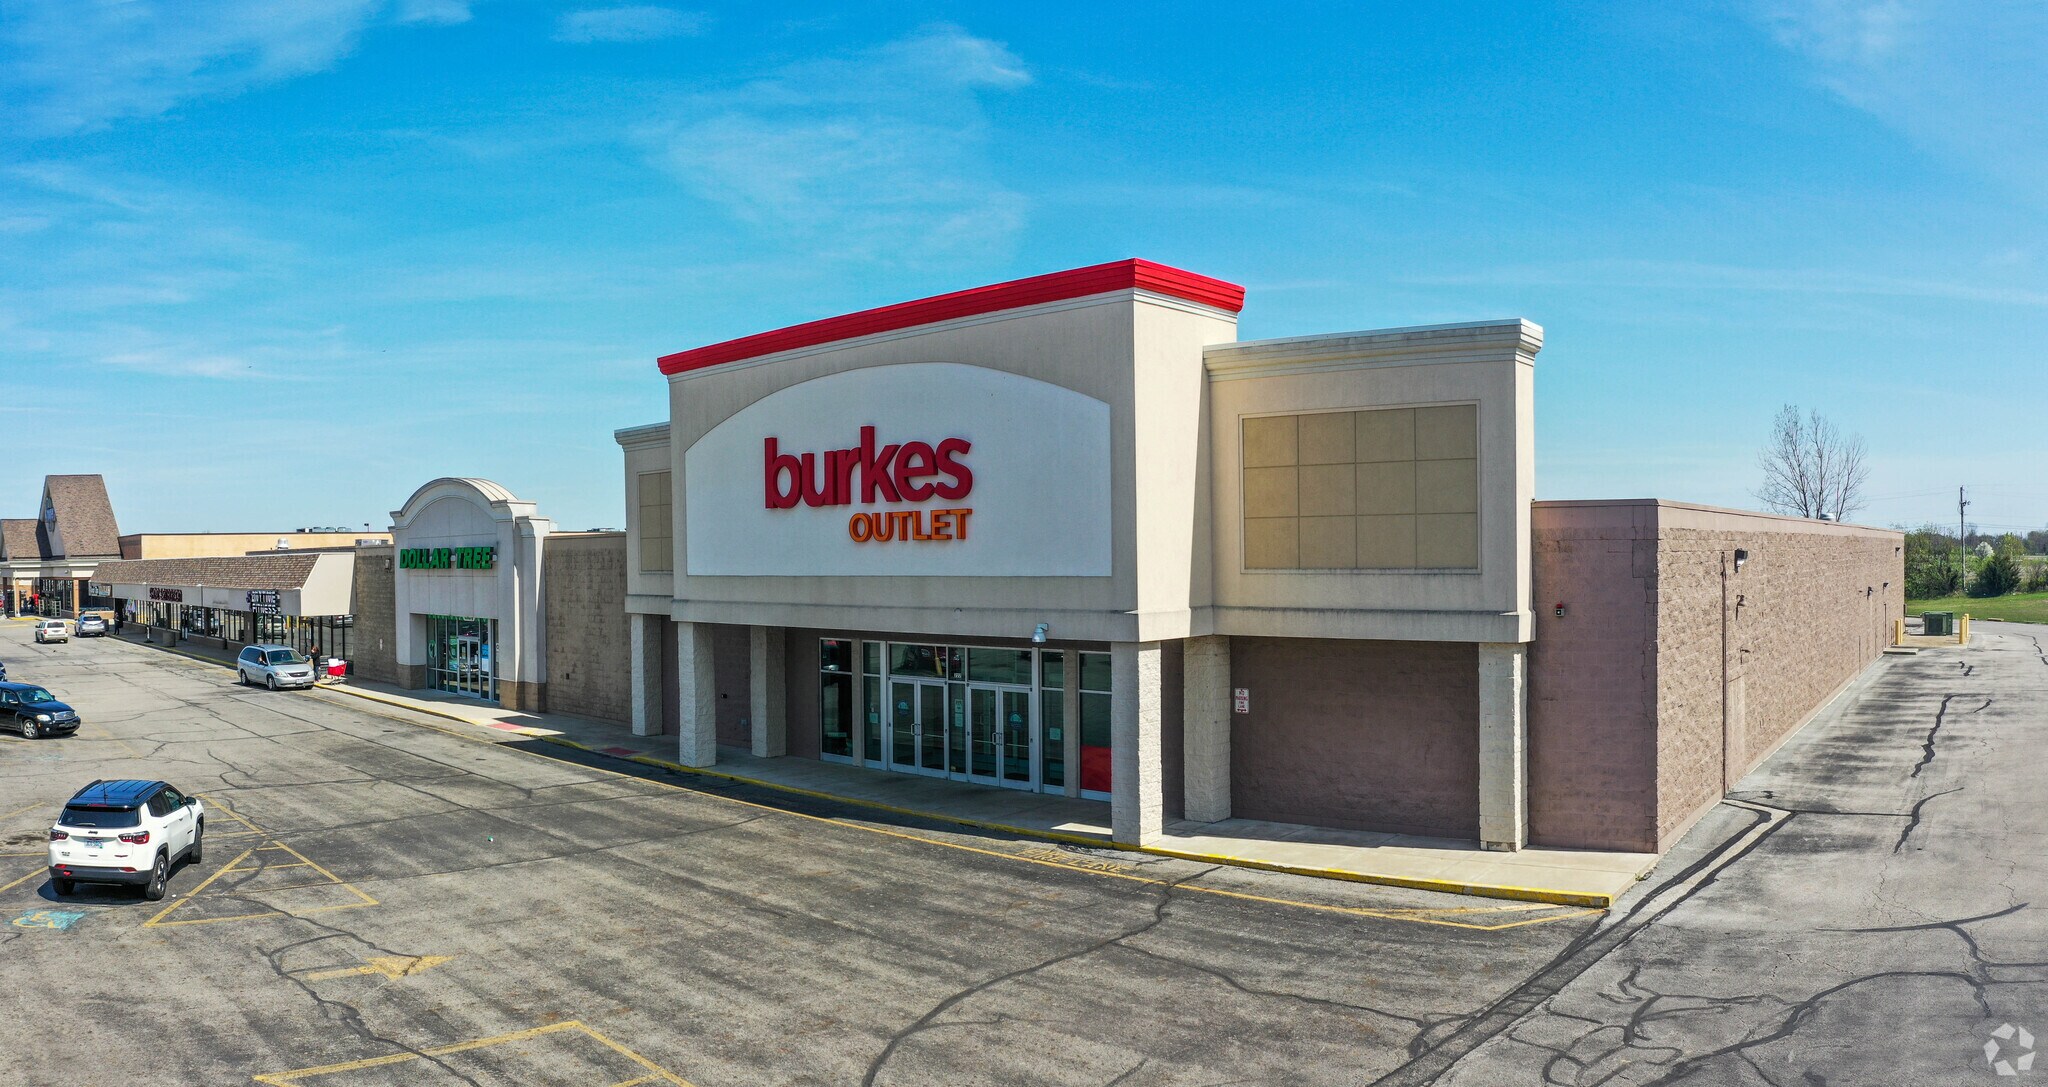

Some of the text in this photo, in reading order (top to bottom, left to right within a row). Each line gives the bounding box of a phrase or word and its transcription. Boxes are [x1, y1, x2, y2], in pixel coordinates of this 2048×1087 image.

[764, 425, 973, 509] burkes
[849, 508, 973, 543] OUTLET
[399, 546, 494, 569] DOLLAR TREE
